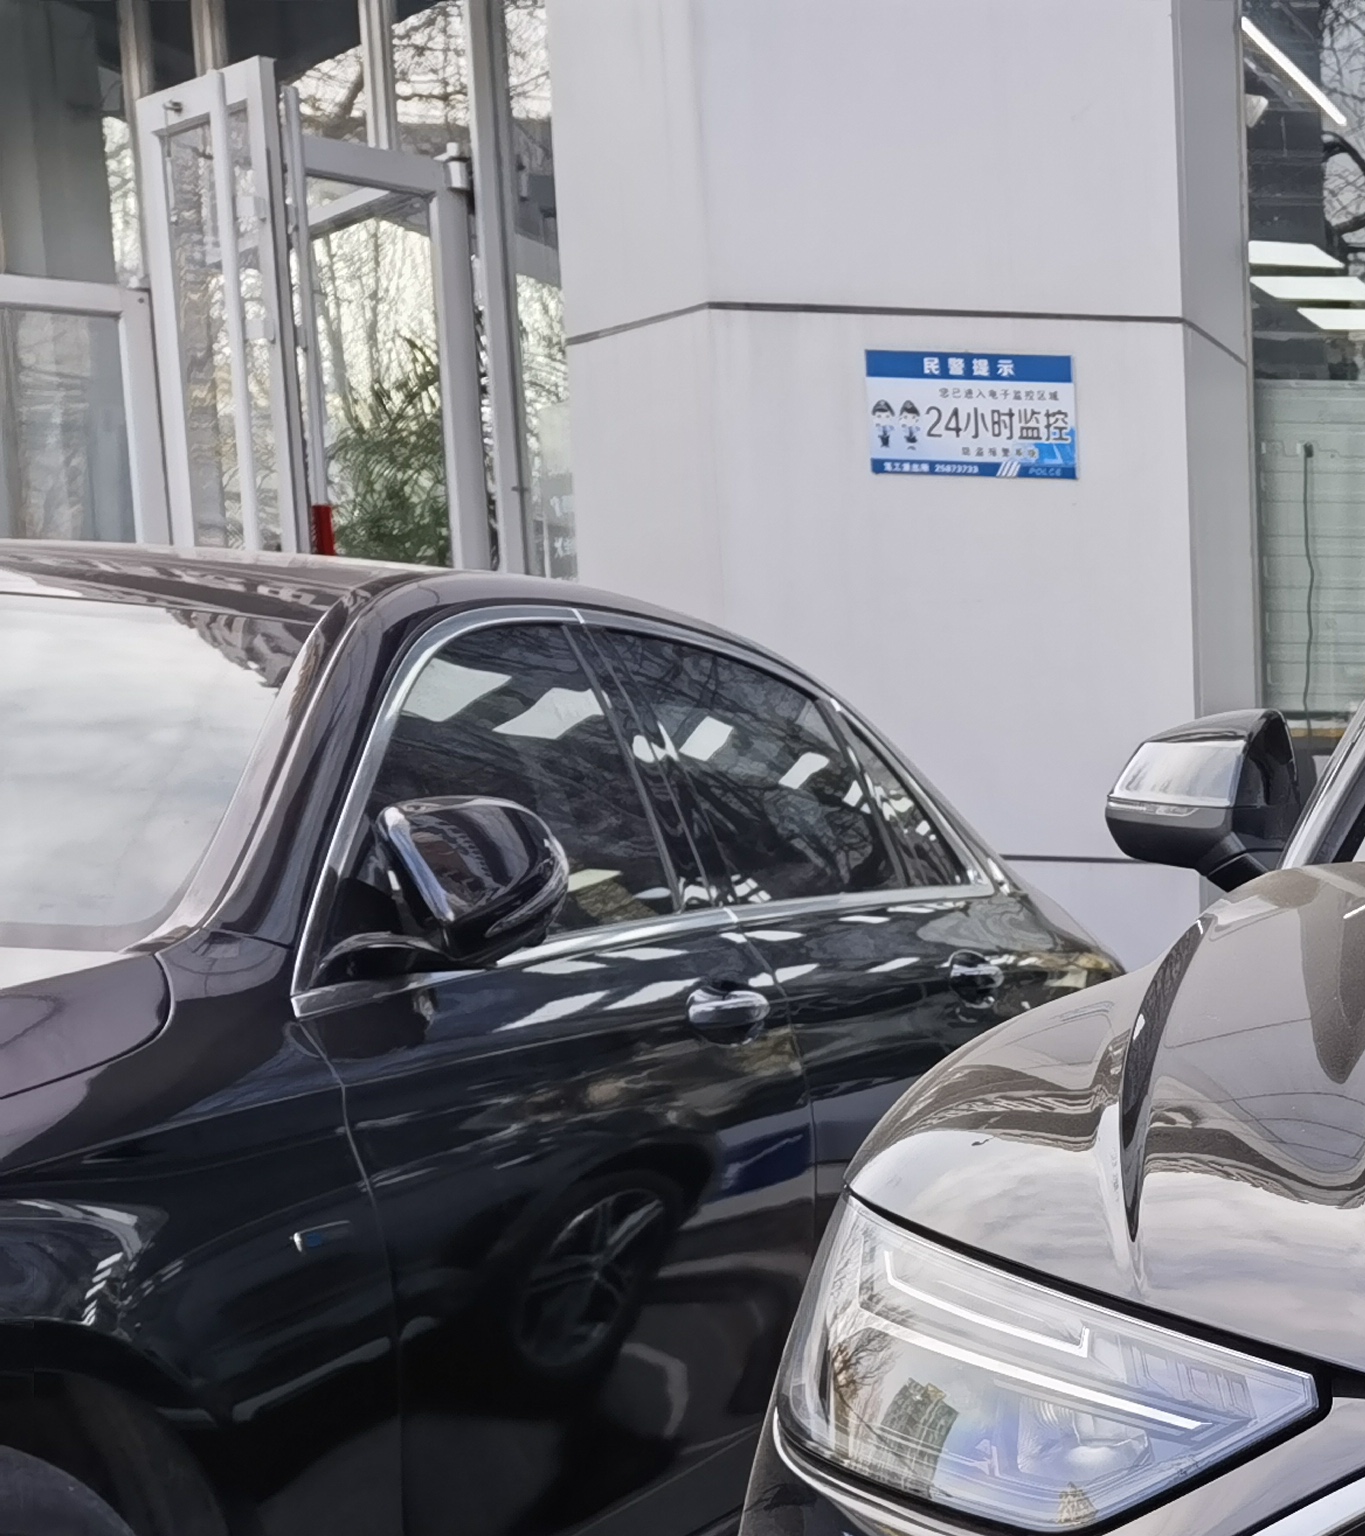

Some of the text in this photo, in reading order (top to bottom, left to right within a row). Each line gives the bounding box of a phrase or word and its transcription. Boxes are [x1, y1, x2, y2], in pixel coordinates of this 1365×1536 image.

[922, 356, 1016, 377] 民警提示
[924, 405, 1071, 441] 24小时监控
